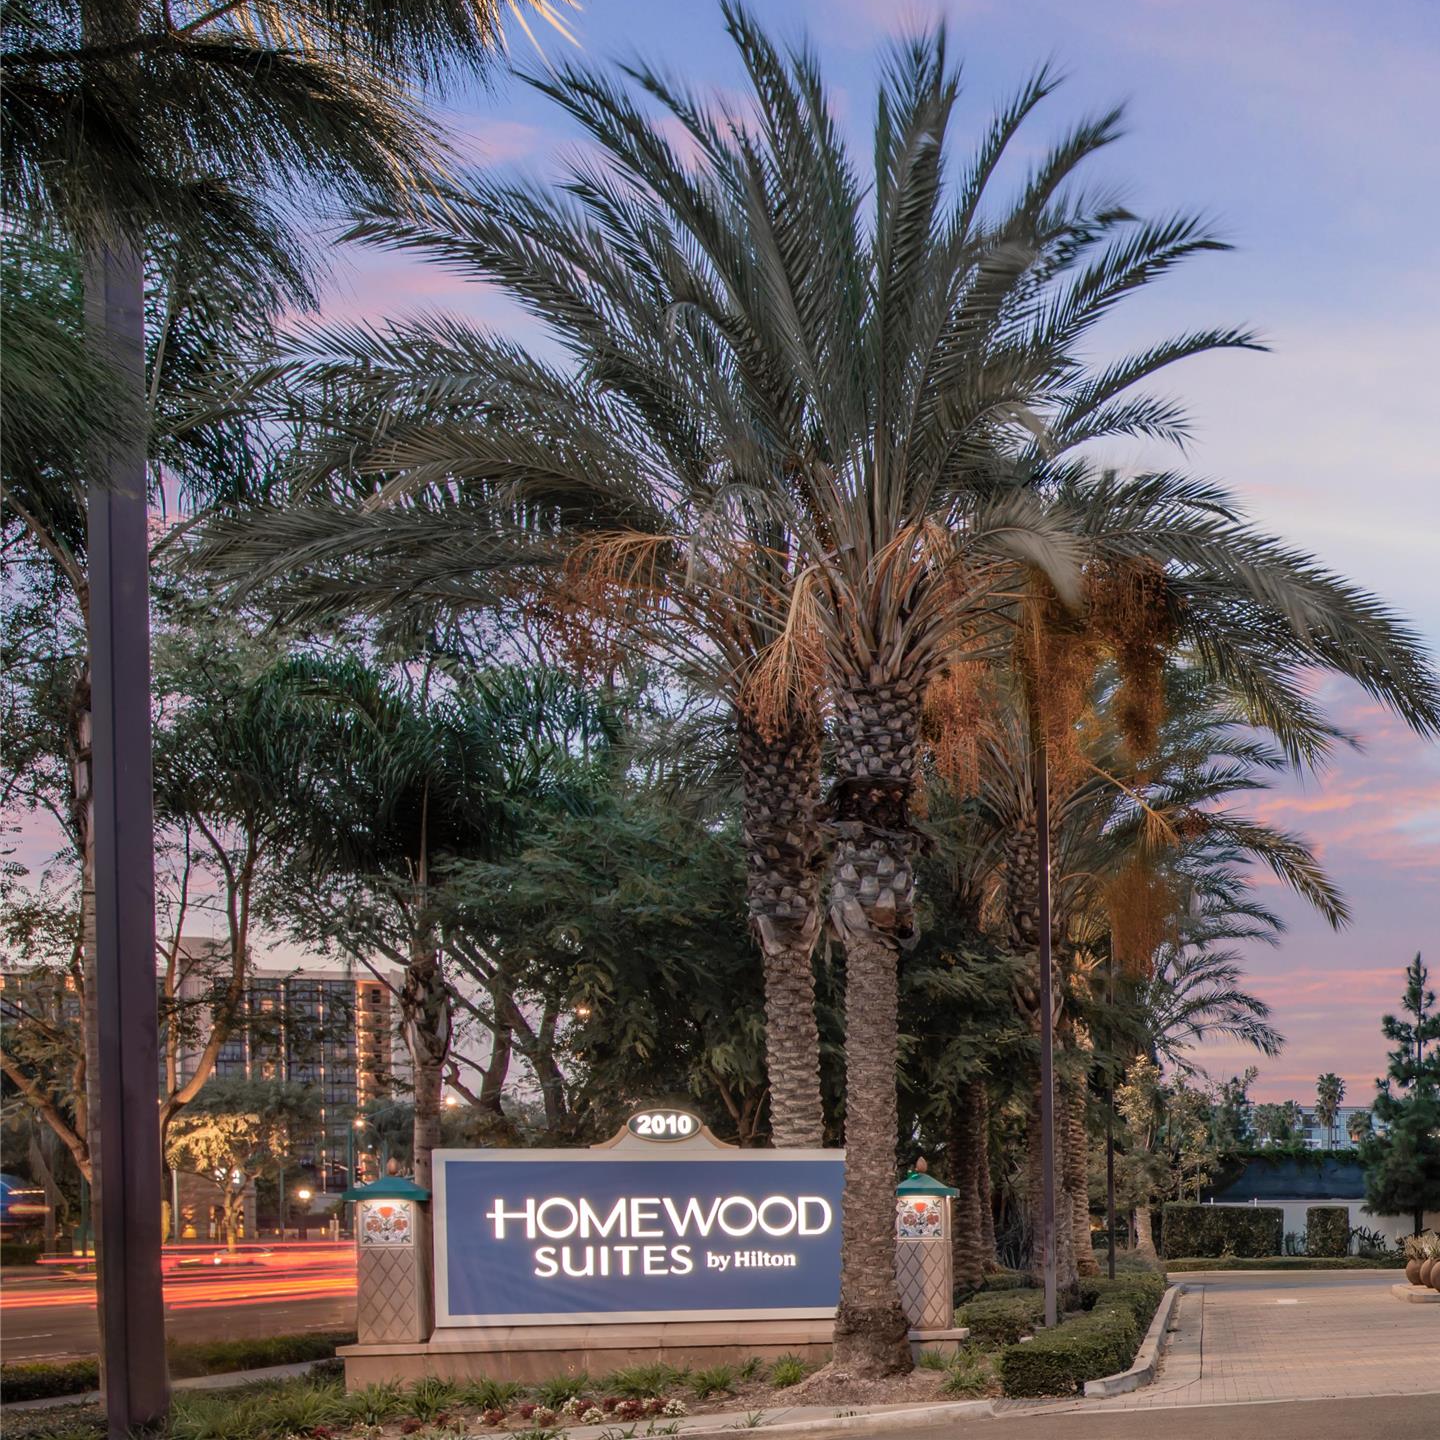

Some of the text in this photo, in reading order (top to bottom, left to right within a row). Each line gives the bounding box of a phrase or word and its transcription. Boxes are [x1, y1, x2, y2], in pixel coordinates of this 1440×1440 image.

[636, 1114, 692, 1135] 2010
[486, 1195, 833, 1240] HOMEWOOD
[534, 1244, 797, 1277] SUITES by Hilton
